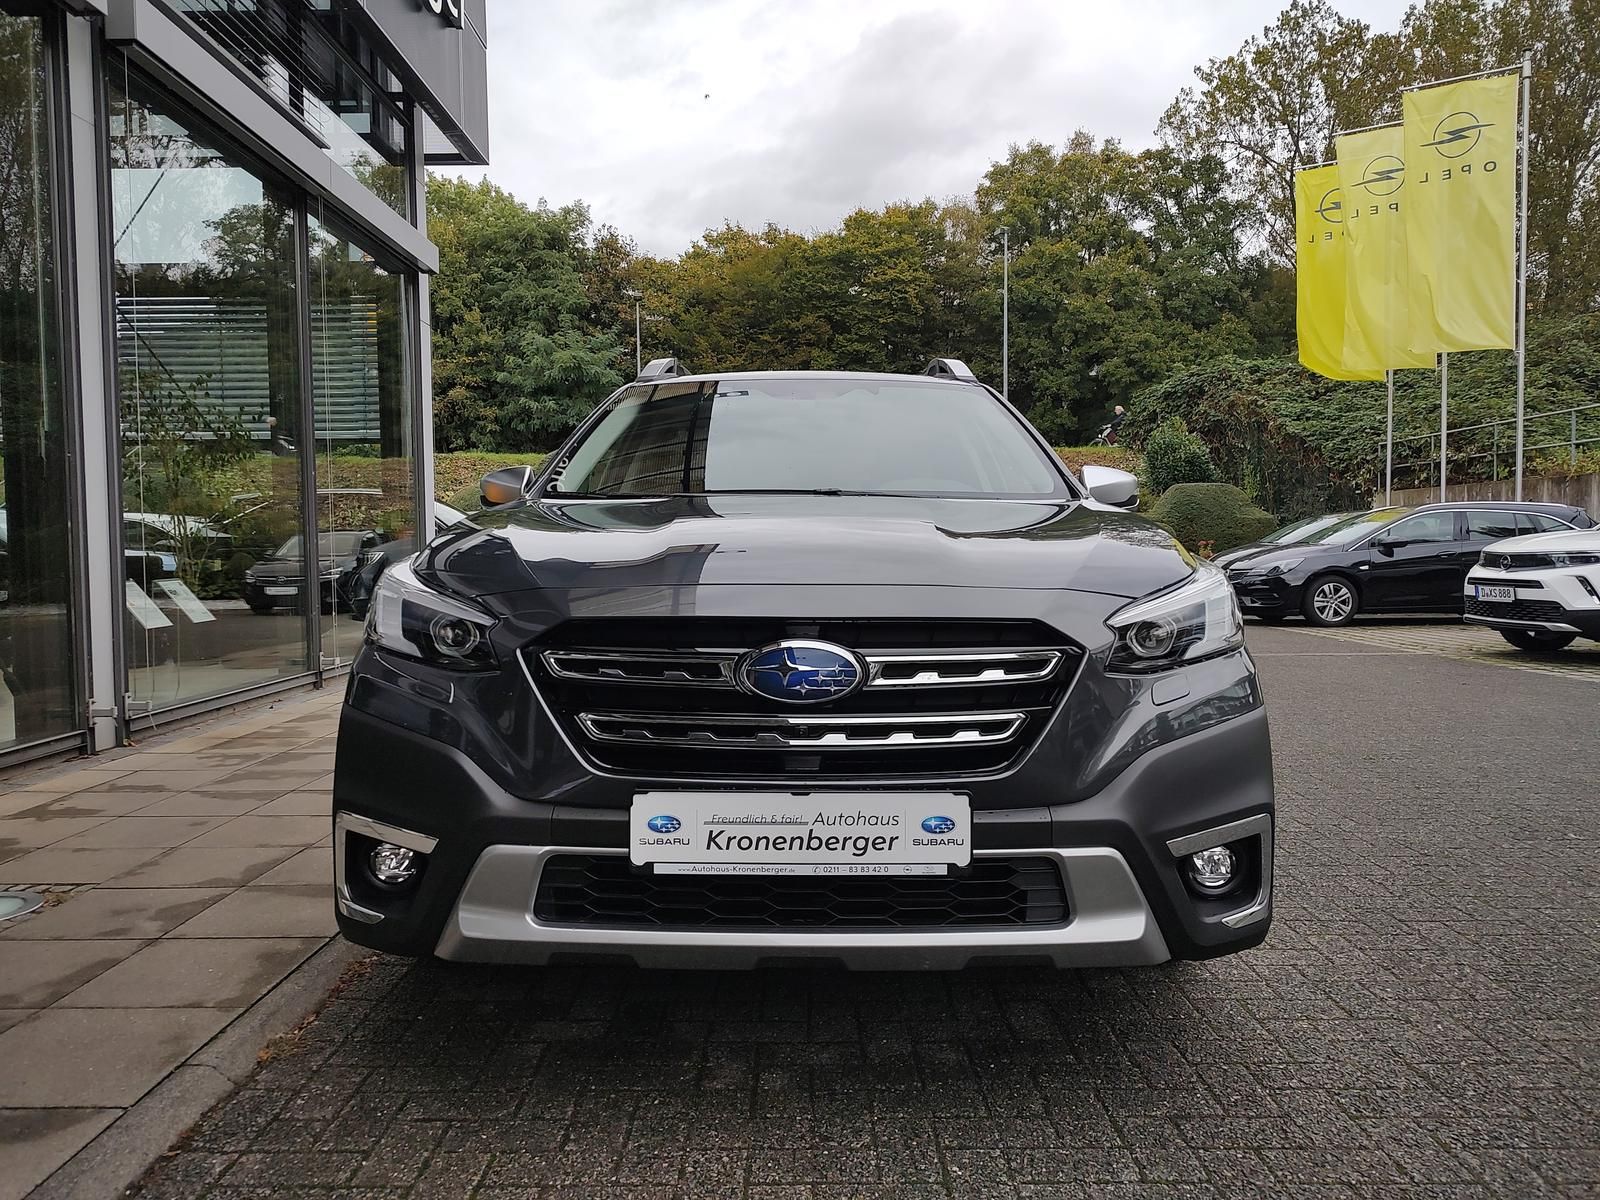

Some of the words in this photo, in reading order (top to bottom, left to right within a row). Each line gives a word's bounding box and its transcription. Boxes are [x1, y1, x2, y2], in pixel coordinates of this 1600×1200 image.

[711, 814, 767, 824] Freundlich
[770, 814, 778, 824] &
[780, 814, 803, 824] fair!
[812, 811, 900, 826] Autohaus
[639, 838, 690, 846] SUBARU
[706, 829, 900, 857] Kronenberger
[912, 838, 965, 846] SUBARU
